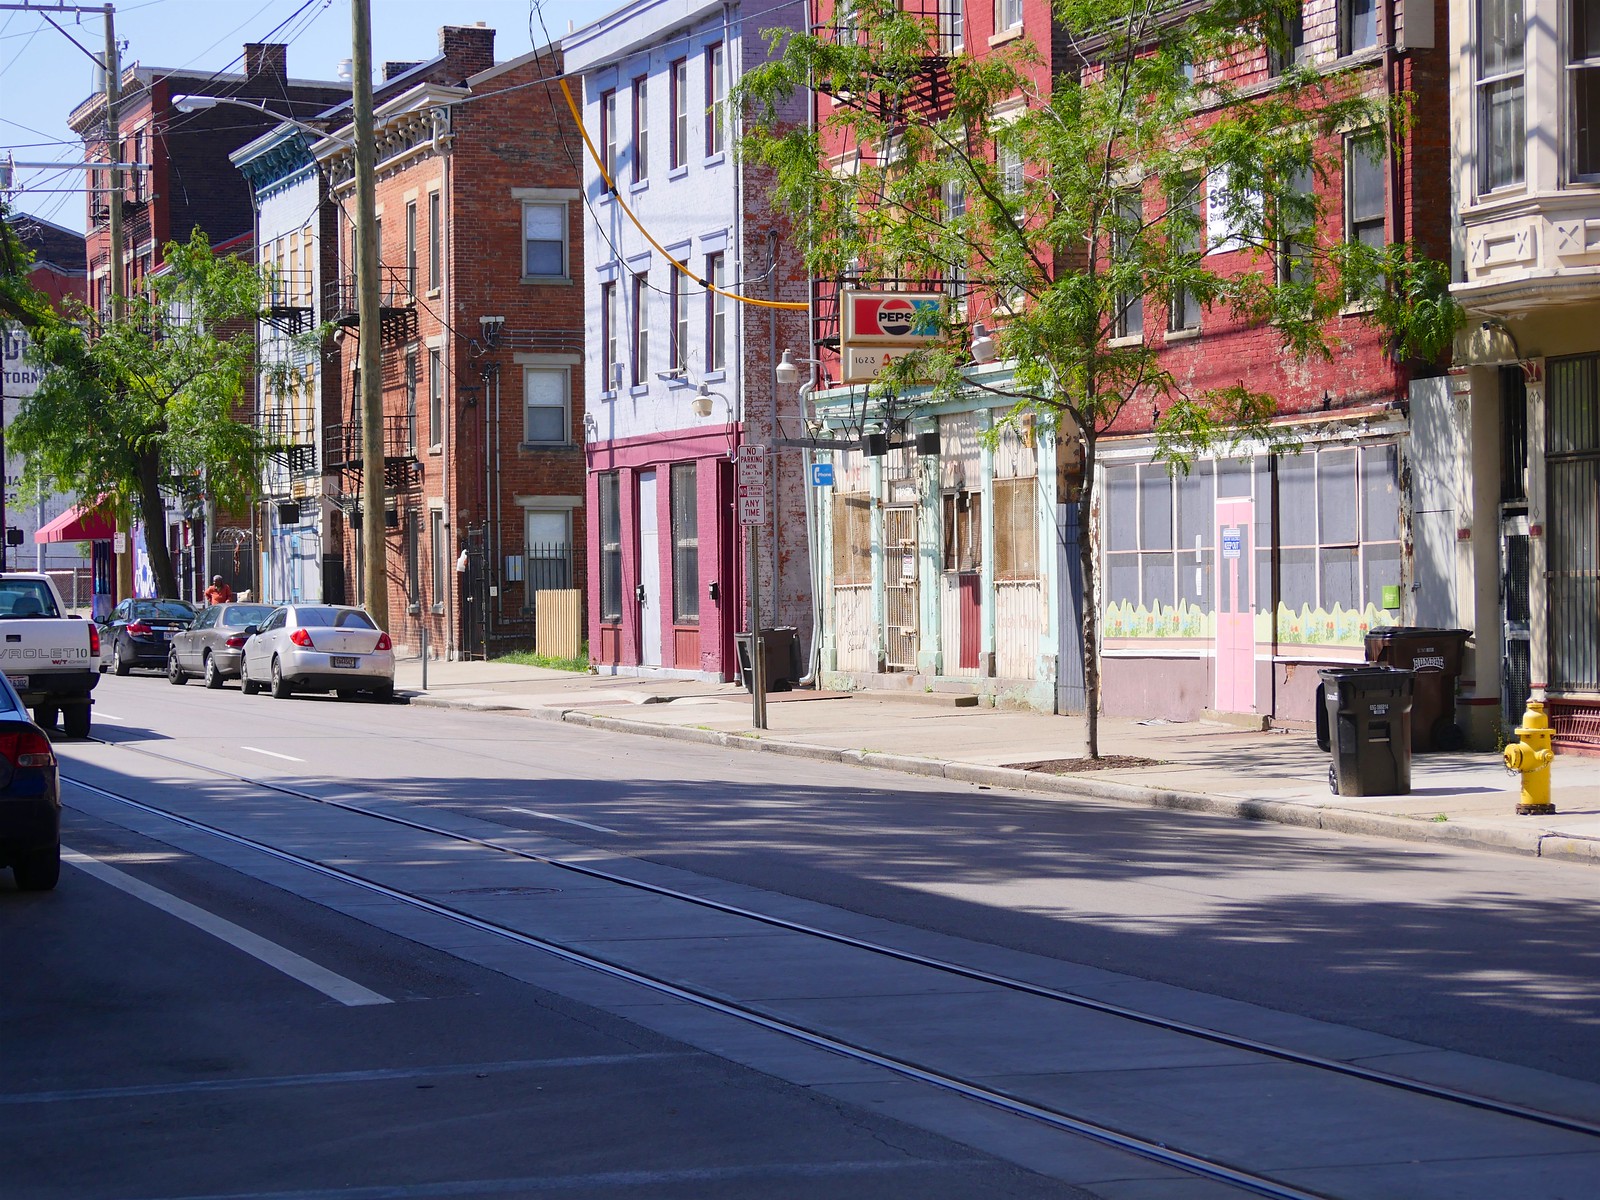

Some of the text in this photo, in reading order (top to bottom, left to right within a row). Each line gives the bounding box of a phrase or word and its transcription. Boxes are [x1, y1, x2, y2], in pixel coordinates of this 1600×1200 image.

[855, 356, 876, 364] 1623
[746, 447, 757, 456] NO
[745, 499, 760, 508] ANY
[745, 509, 761, 517] TIME
[75, 648, 88, 658] 10
